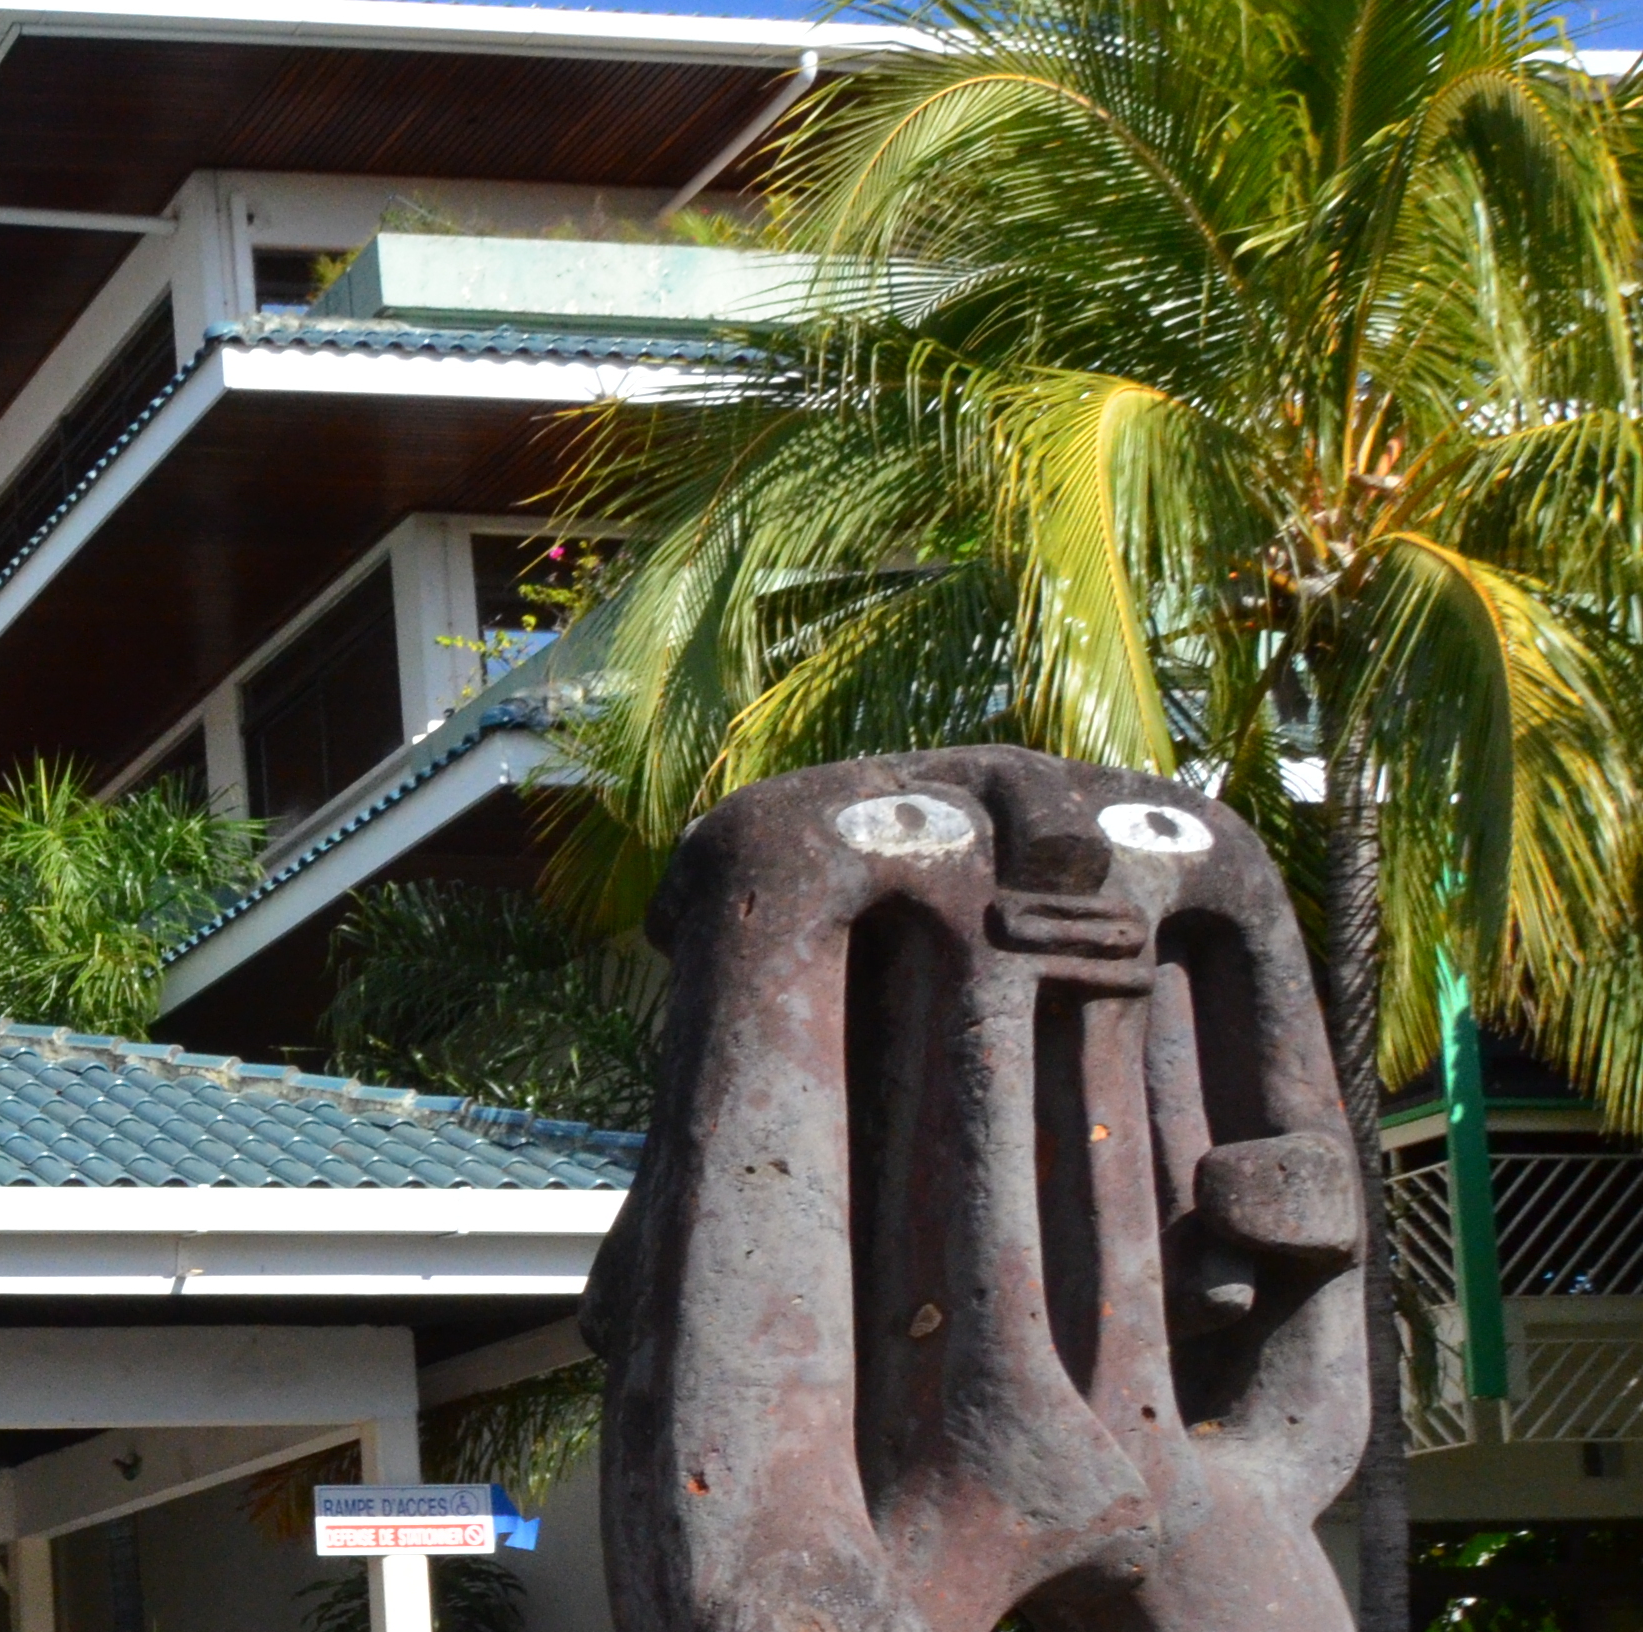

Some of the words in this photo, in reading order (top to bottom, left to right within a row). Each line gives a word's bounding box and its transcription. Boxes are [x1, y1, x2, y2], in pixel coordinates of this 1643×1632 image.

[323, 1499, 375, 1517] RAMPE
[381, 1497, 448, 1517] D'ACCES
[325, 1527, 377, 1548] DEFENSE
[378, 1527, 396, 1547] DE
